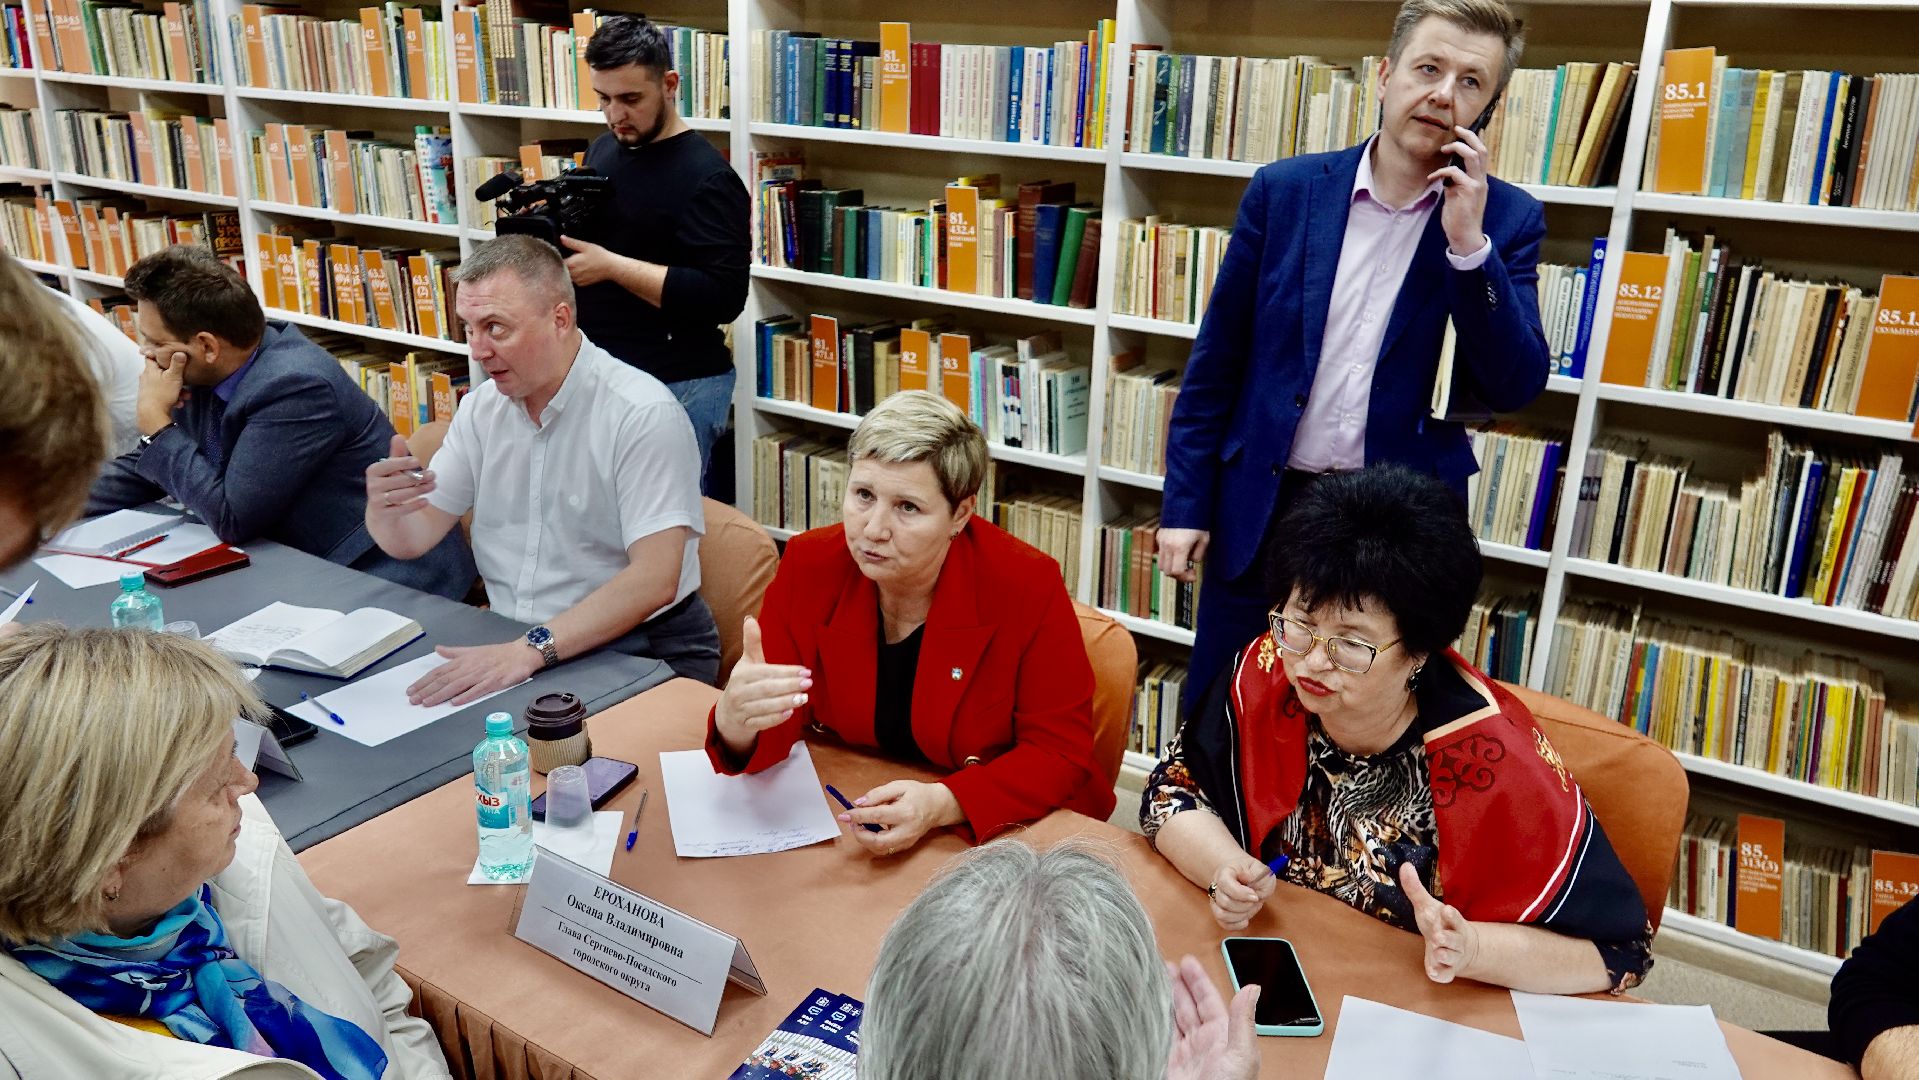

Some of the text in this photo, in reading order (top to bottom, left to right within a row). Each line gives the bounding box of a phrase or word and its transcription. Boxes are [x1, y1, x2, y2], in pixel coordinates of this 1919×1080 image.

[1665, 81, 1706, 100] 85.1
[950, 212, 968, 225] 81.
[1618, 283, 1662, 300] 85.12
[1878, 308, 1919, 326] 85.1
[902, 351, 917, 364] 82
[943, 357, 959, 370] 83
[1741, 842, 1769, 860] 85.
[593, 885, 664, 929] ЕРОХАНОВА
[567, 894, 684, 959] Оксана Владимировна
[558, 921, 677, 988] Глава Сергиево-Посадского
[573, 947, 651, 993] городского округа
